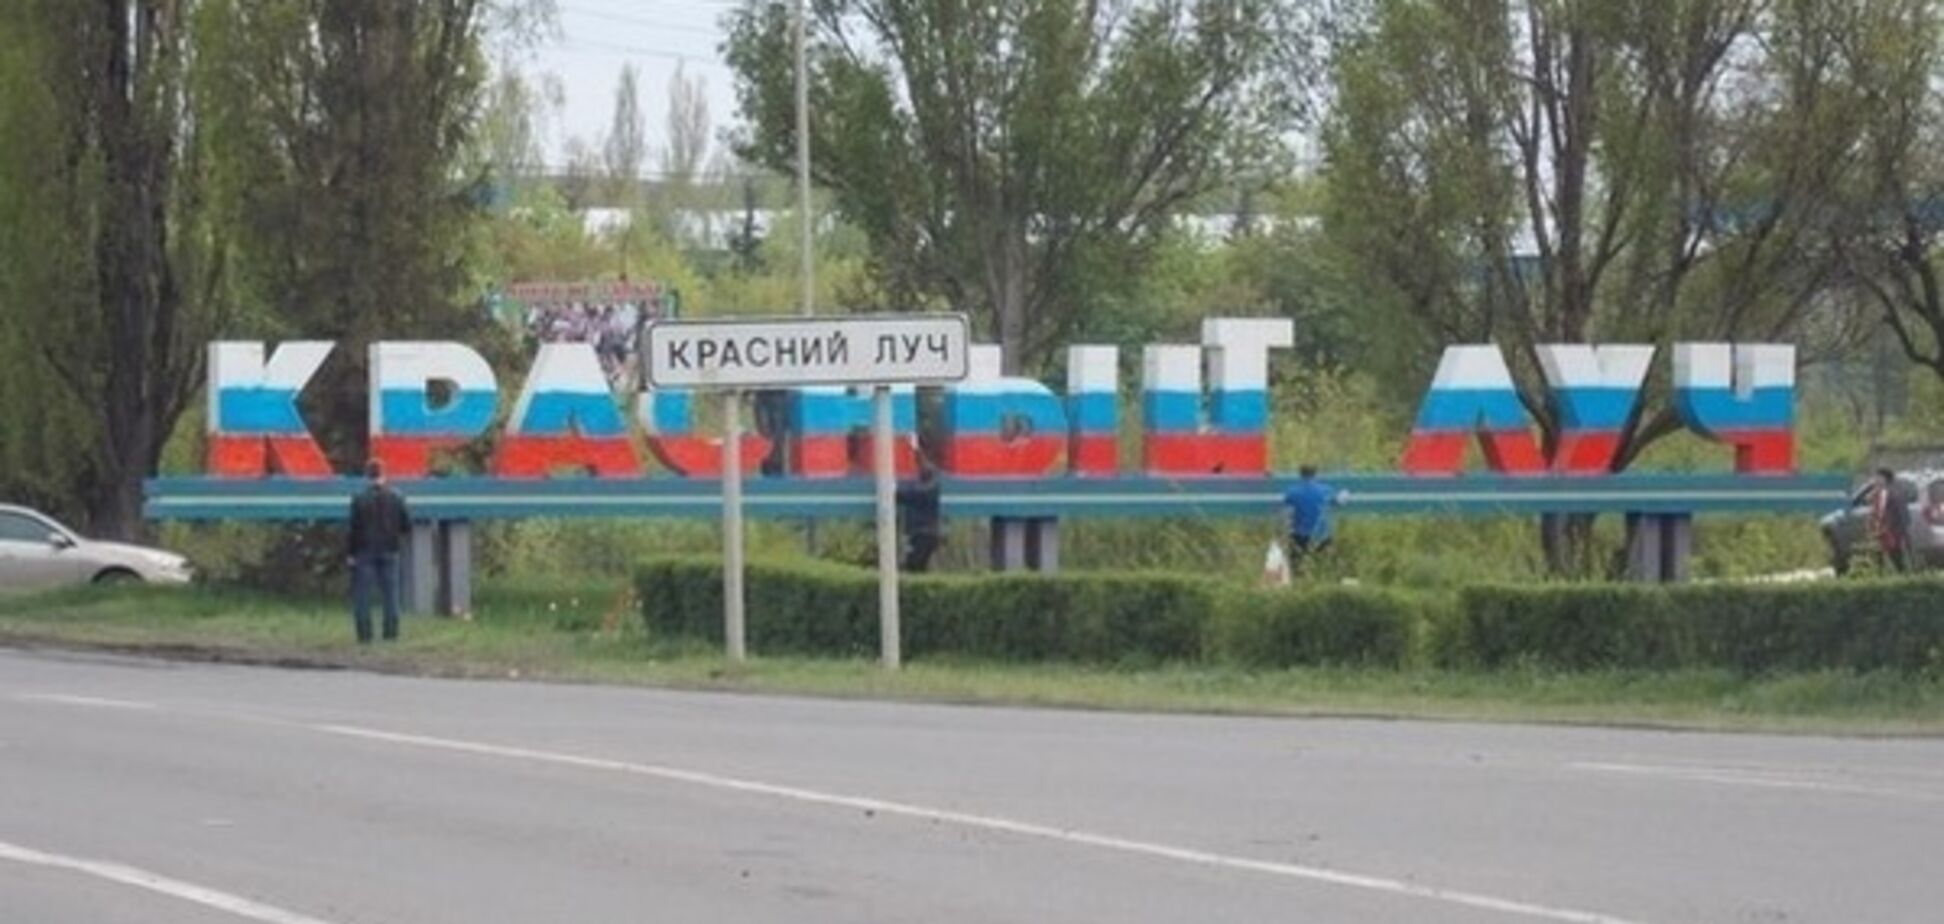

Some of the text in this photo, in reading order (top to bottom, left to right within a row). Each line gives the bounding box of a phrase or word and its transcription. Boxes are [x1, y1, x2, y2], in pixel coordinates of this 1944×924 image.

[667, 331, 950, 369] КРАСНИЙ ЛУЧ
[1402, 343, 1797, 475] ЛУЧ
